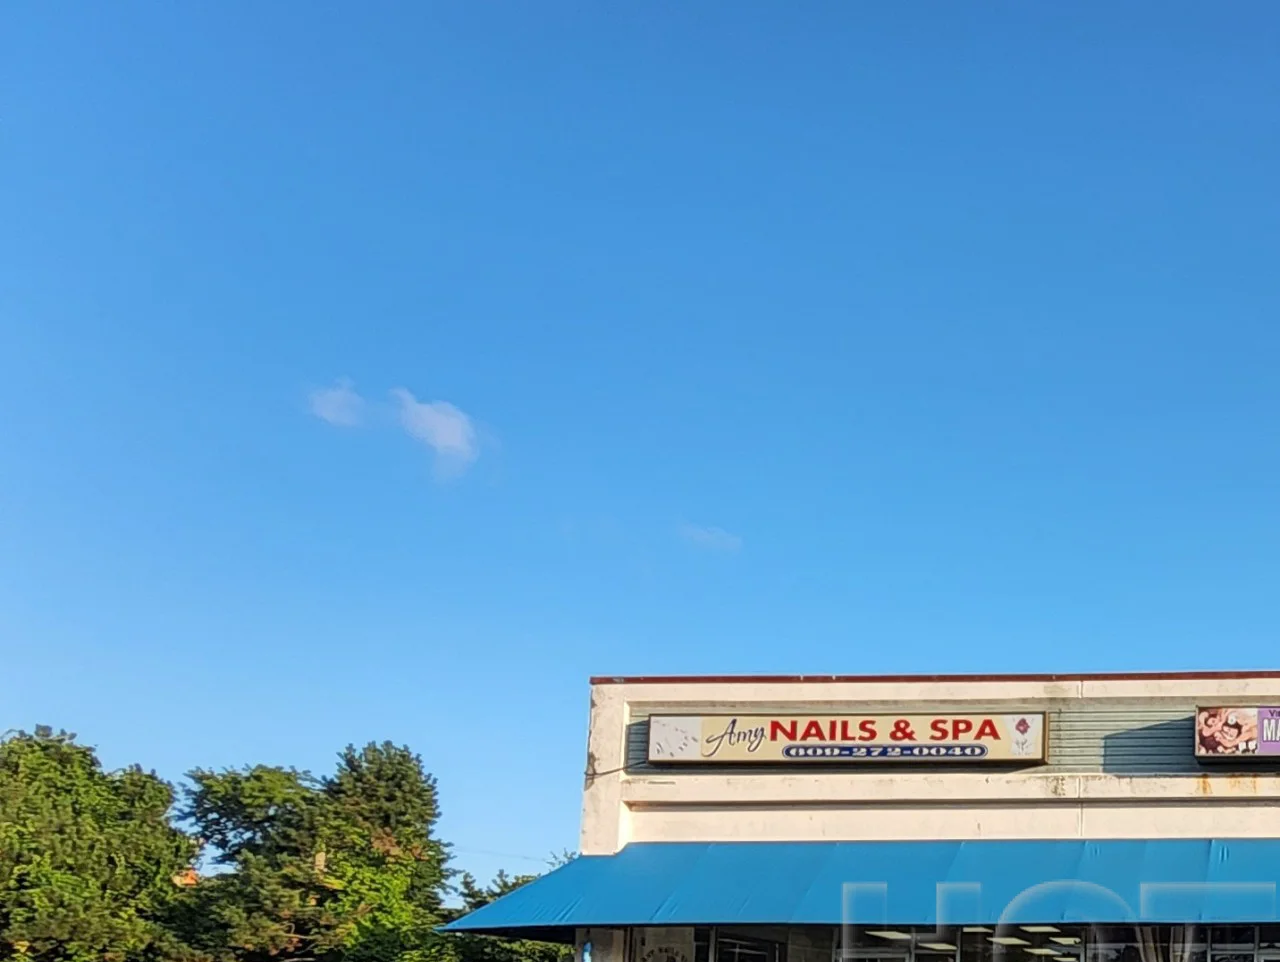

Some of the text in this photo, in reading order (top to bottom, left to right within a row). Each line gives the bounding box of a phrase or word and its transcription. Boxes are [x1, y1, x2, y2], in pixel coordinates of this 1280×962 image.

[701, 718, 1002, 757] Amy NAILS & SPA
[788, 746, 983, 757] 609-272-0040
